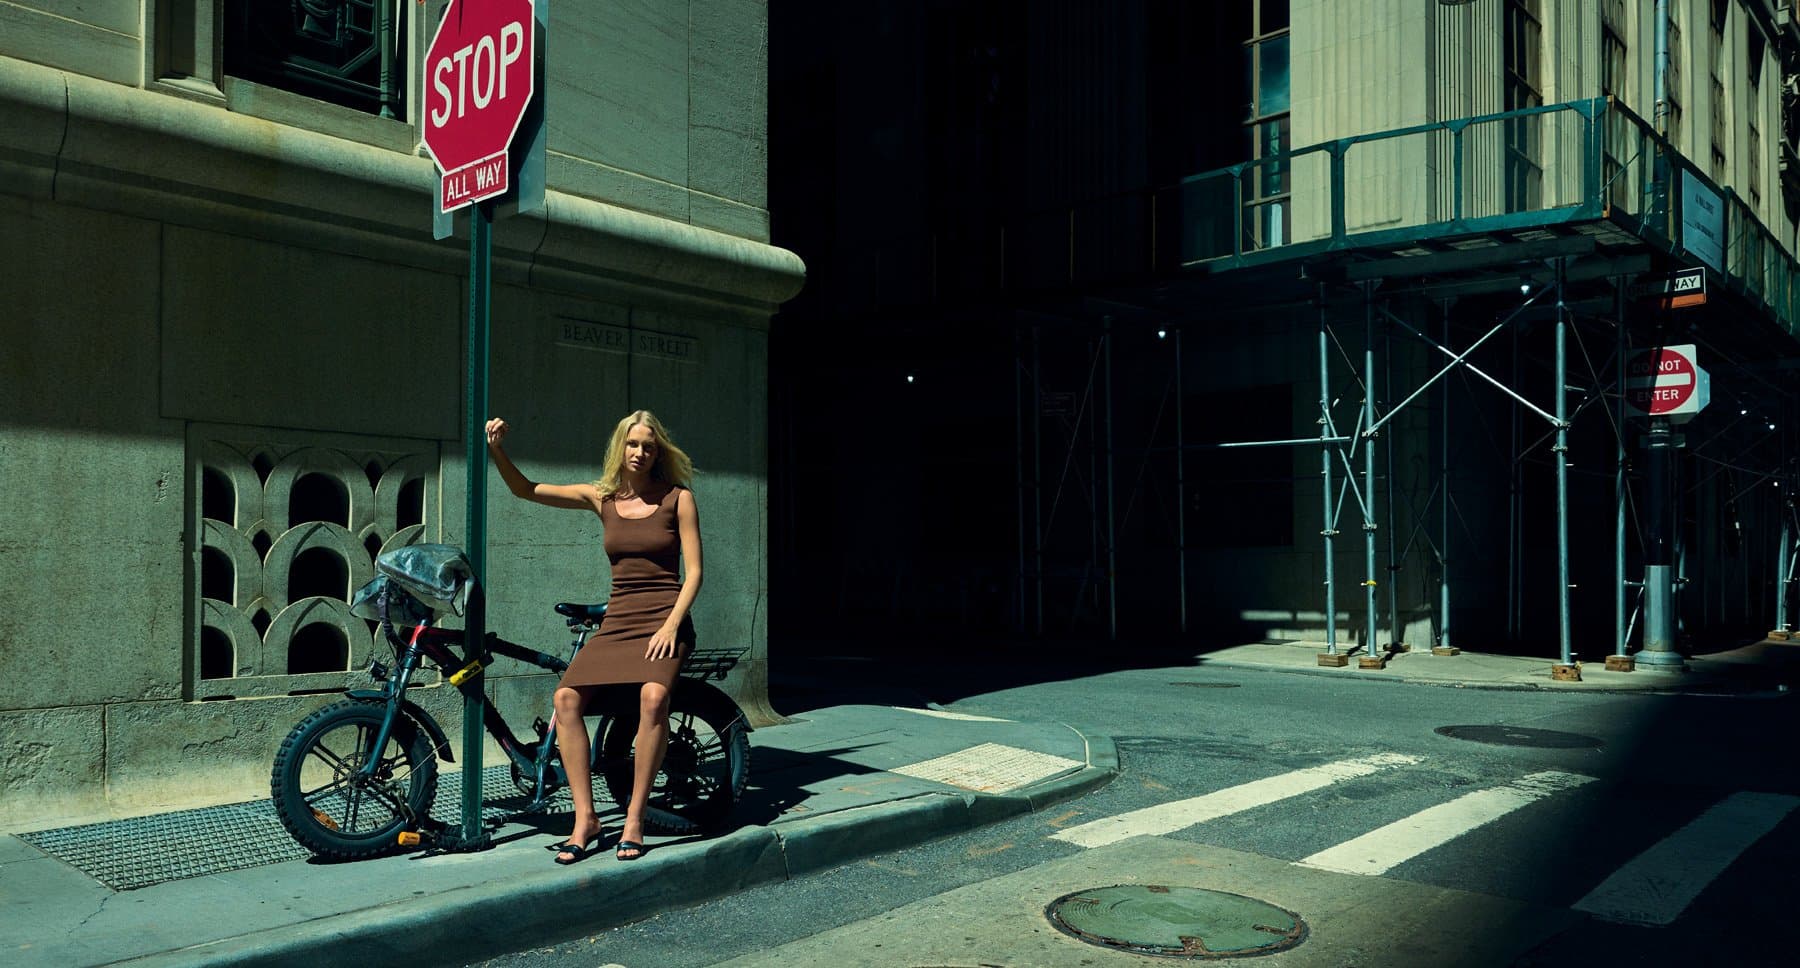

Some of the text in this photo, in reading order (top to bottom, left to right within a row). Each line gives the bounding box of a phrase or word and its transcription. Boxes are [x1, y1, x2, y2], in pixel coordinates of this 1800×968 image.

[431, 21, 524, 128] STOP
[446, 160, 502, 202] ALL WAY
[563, 324, 690, 356] BEAVER STREET
[1656, 359, 1681, 372] NOT
[1637, 388, 1679, 401] ENTER
